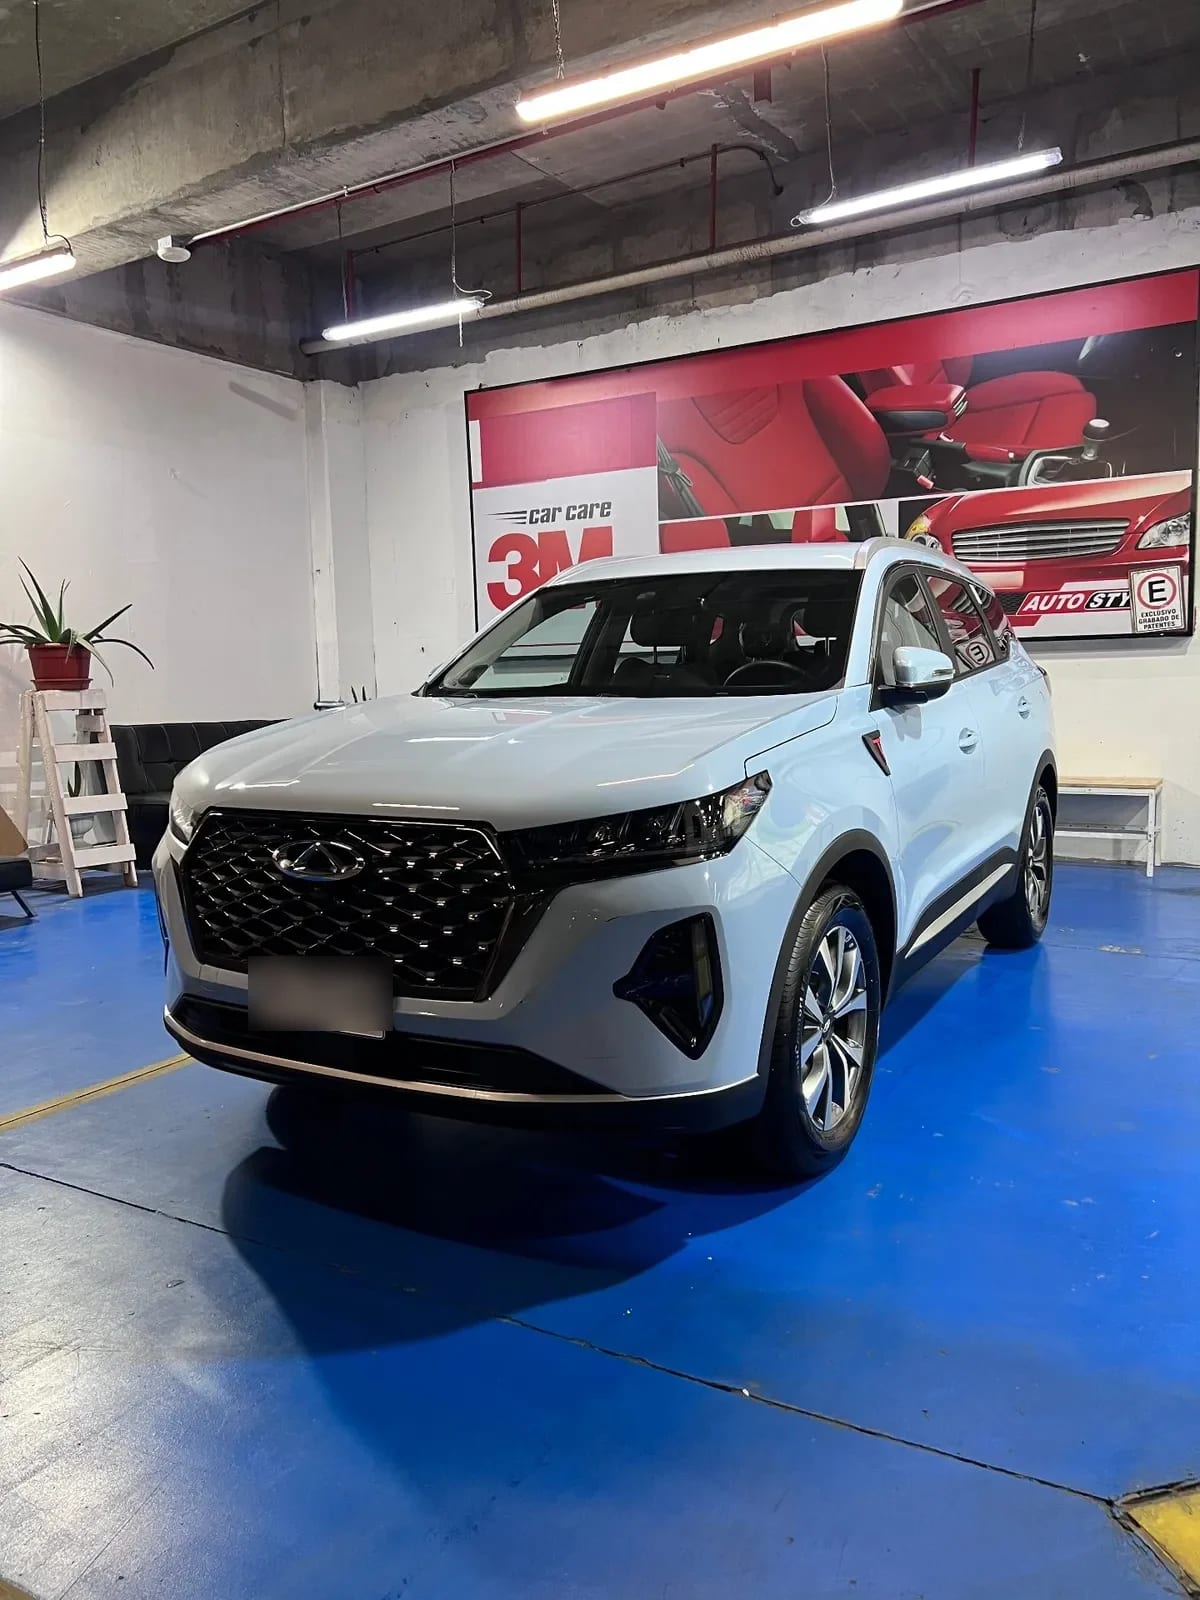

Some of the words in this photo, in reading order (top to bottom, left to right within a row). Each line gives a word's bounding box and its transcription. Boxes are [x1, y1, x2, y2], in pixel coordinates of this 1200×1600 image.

[528, 506, 562, 525] car
[565, 501, 612, 521] care
[487, 525, 613, 611] 3M
[1148, 580, 1167, 603] E
[1022, 593, 1085, 611] AUTO
[1138, 615, 1169, 624] GRABADO
[1141, 608, 1176, 618] EXCLUSIVO
[1143, 621, 1176, 629] PATENTES
